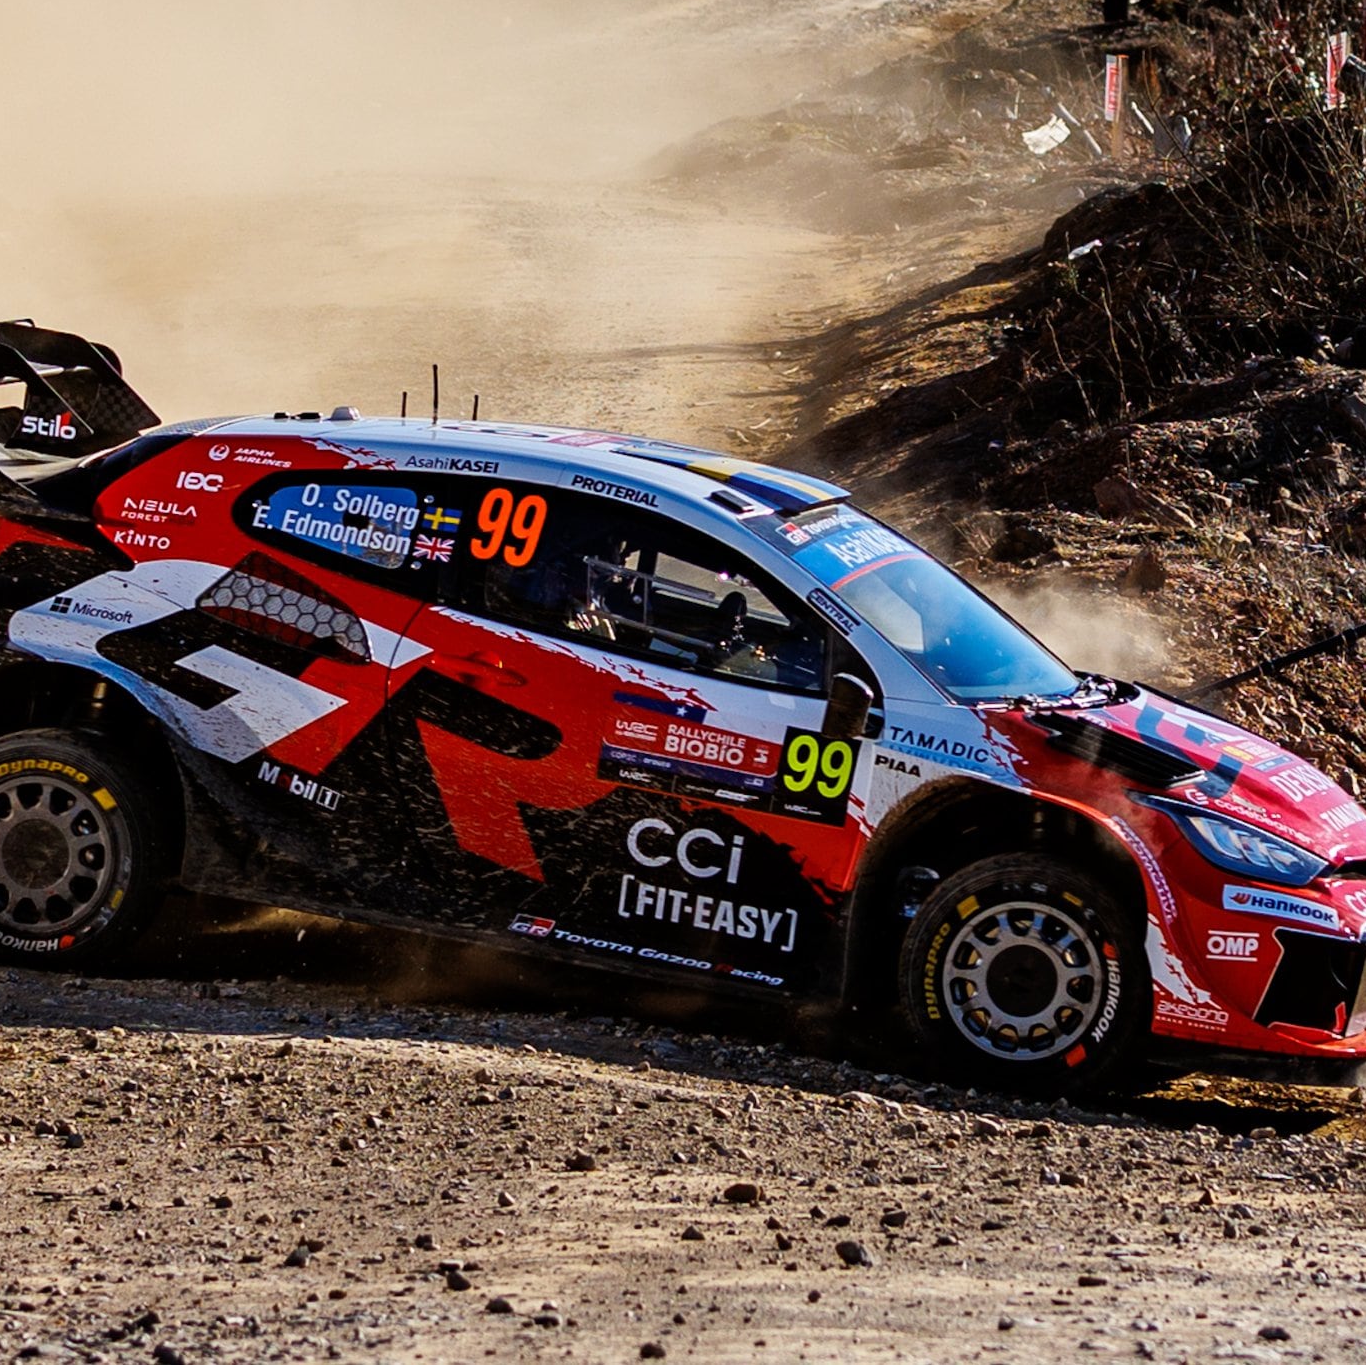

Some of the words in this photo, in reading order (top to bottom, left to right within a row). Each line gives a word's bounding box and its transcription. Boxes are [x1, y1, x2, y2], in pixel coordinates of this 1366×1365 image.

[21, 411, 77, 441] Stilo
[233, 456, 292, 468] AIRLINES
[234, 447, 275, 458] JAPAN
[301, 483, 324, 508] O.
[333, 489, 420, 530] Solberg
[571, 474, 660, 508] PROTERIAL
[121, 510, 168, 523] FOREST
[252, 505, 274, 530] E.
[281, 509, 411, 555] Edmondson
[470, 488, 548, 567] 99
[72, 602, 133, 624] Microsoft
[890, 725, 990, 763] TAMADIC
[257, 761, 318, 802] Mobil
[783, 735, 853, 798] 99
[874, 753, 921, 778] PIAA
[554, 928, 635, 954] TOYOTA
[714, 962, 784, 987] Racing
[1207, 936, 1259, 955] OMP
